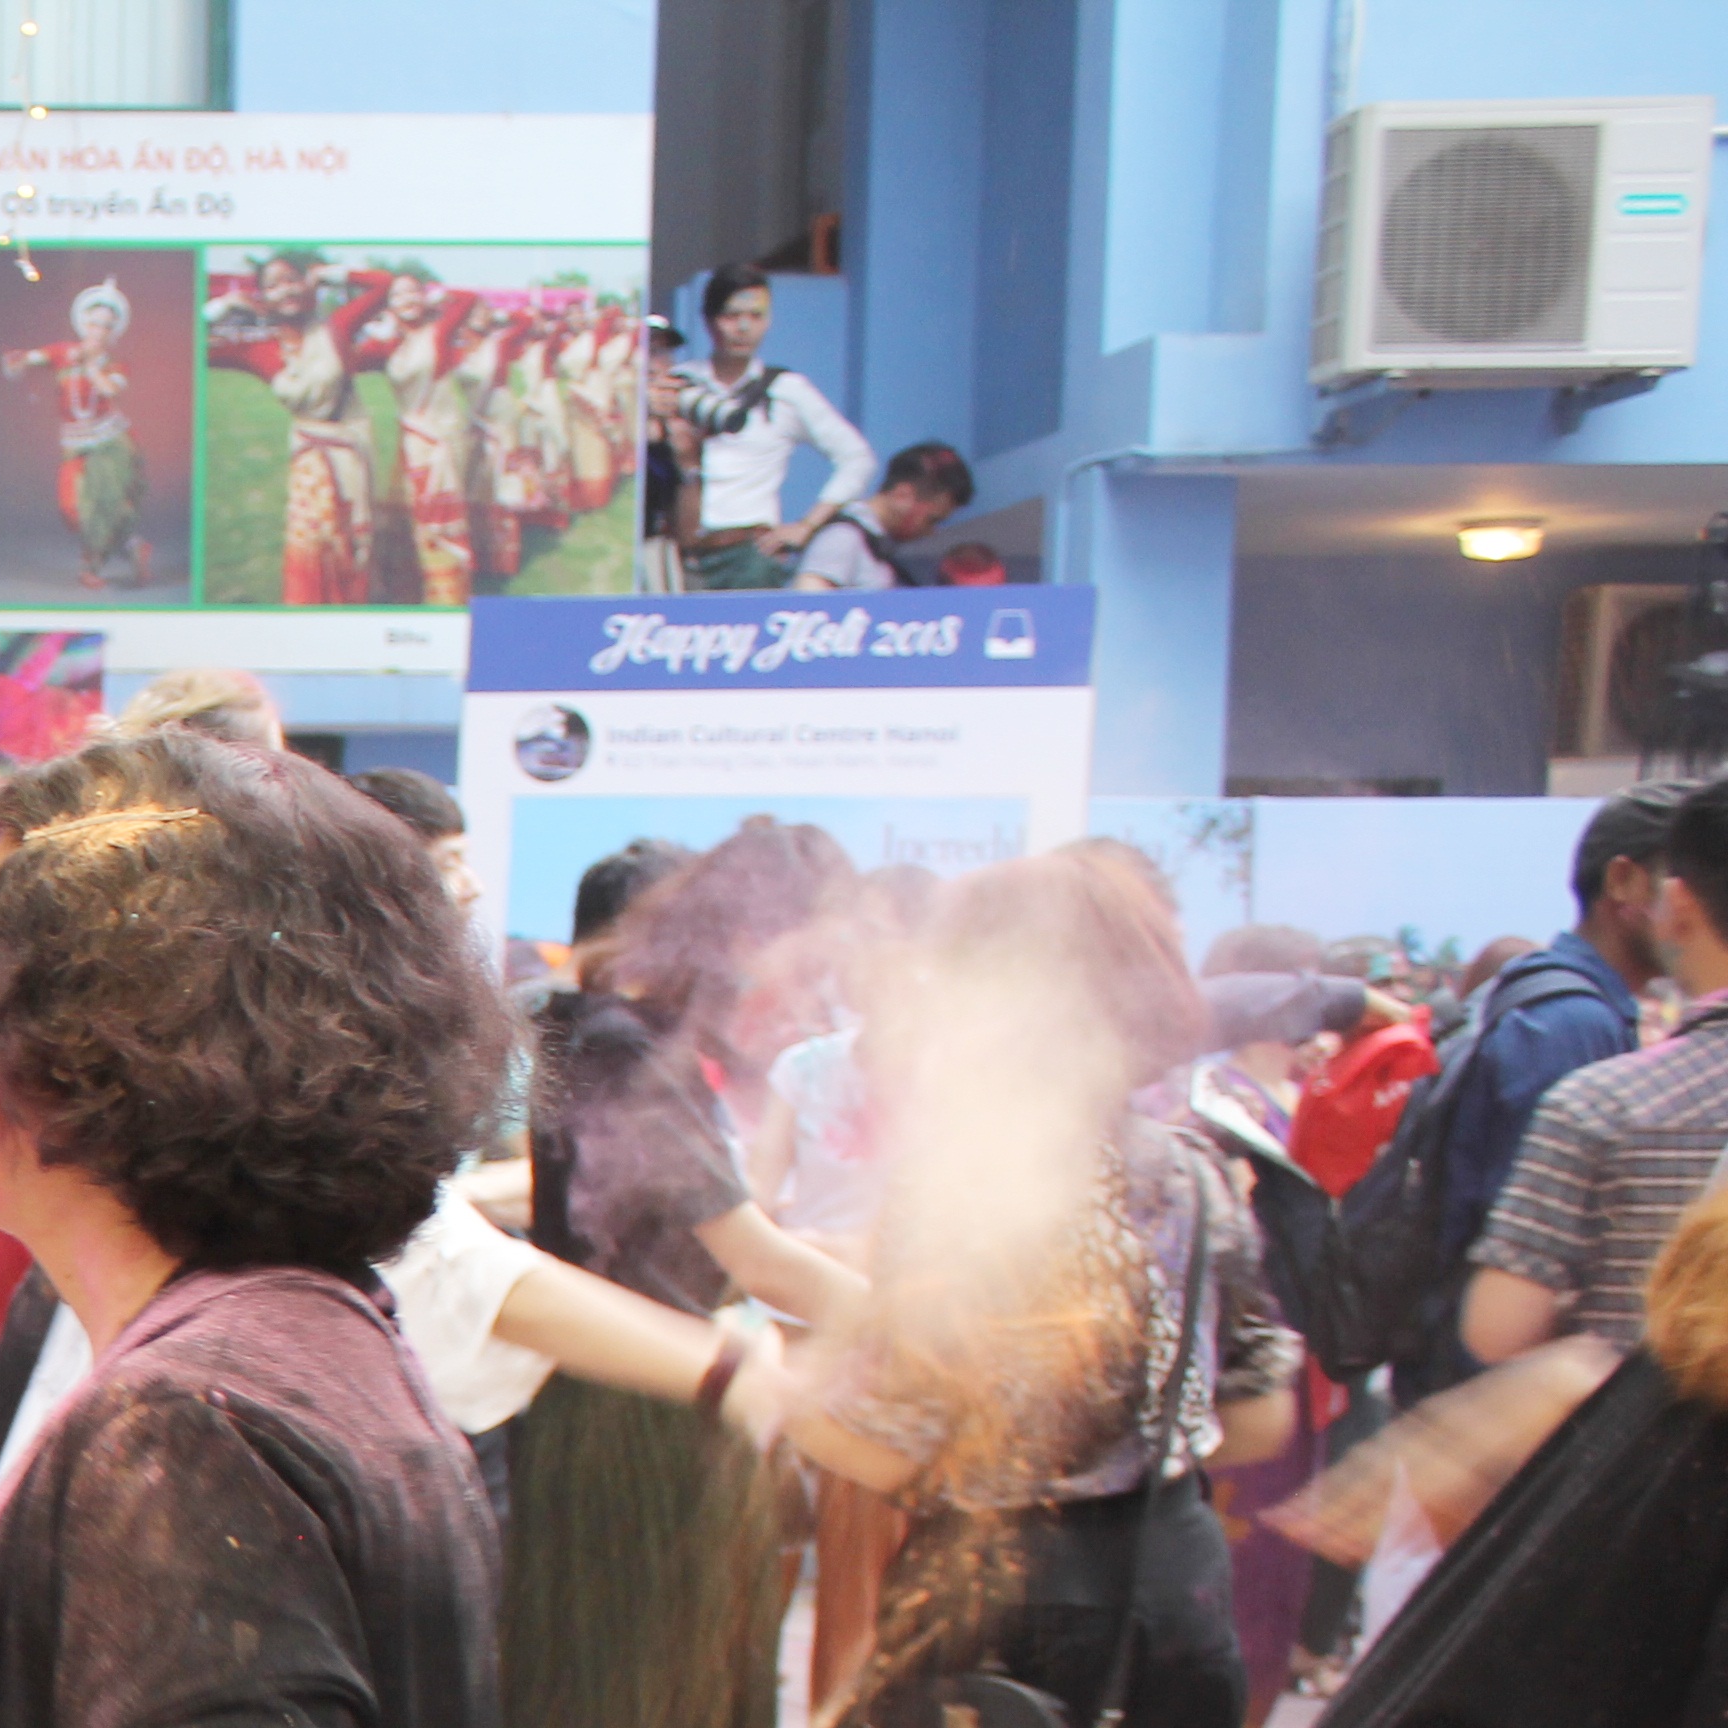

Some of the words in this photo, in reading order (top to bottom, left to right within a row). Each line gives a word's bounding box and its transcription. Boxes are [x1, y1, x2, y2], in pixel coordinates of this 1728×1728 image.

[589, 612, 760, 674] Happy
[750, 606, 872, 672] Holi
[606, 724, 682, 744] Indian
[689, 723, 786, 744] Cultural
